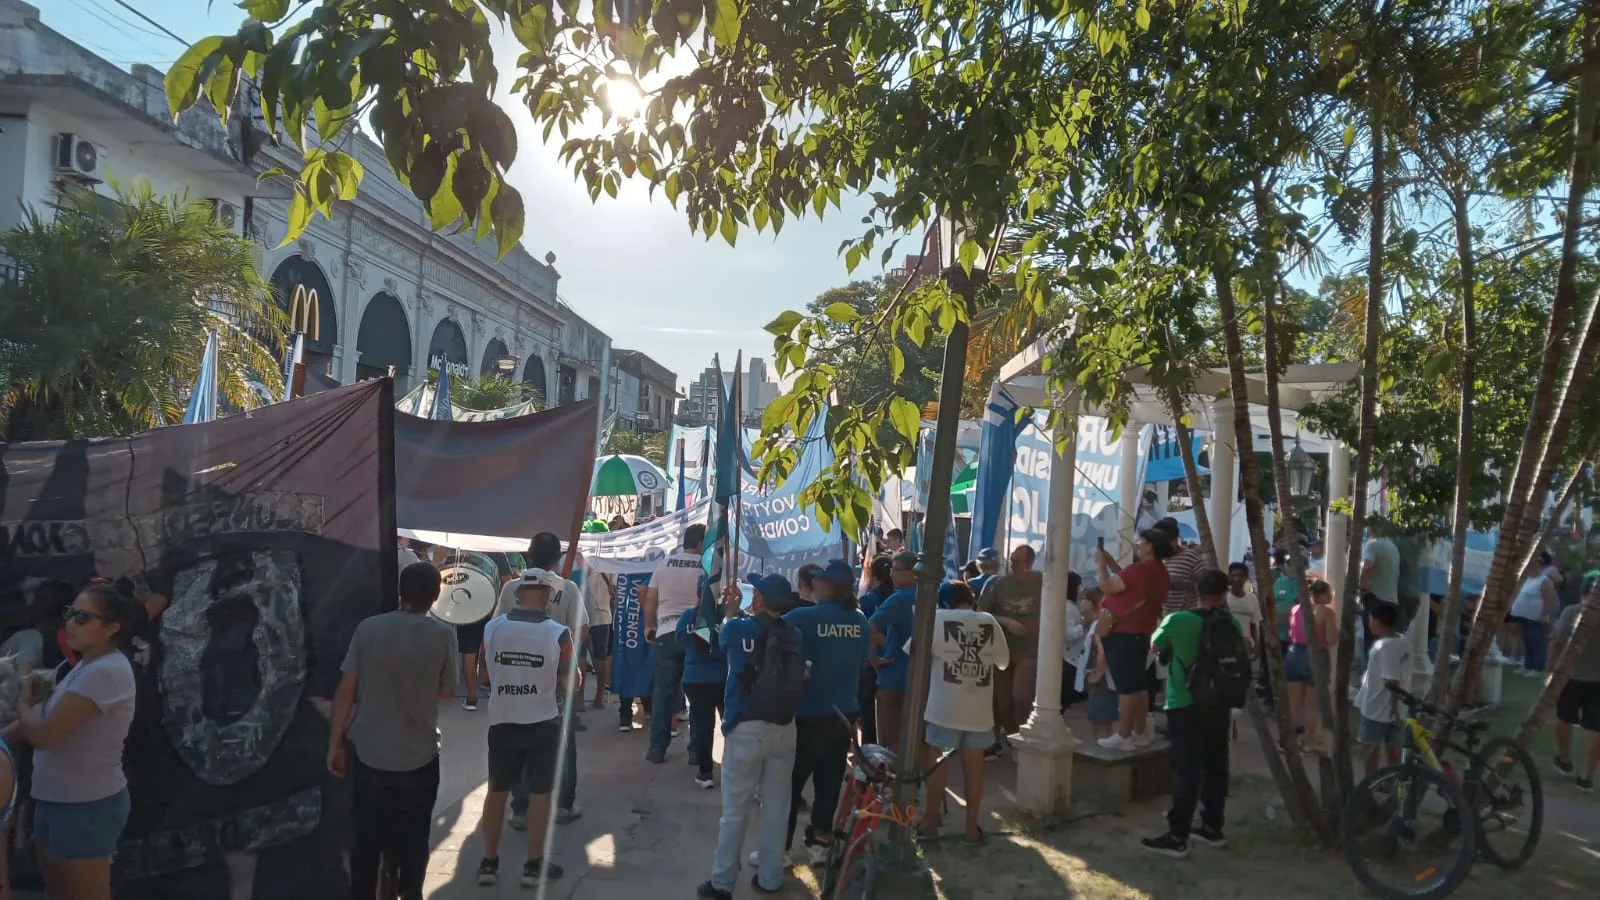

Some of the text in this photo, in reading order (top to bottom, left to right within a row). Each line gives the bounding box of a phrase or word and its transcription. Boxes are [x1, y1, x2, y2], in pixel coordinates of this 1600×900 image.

[817, 623, 861, 639] UATRE
[964, 646, 977, 662] IS
[497, 683, 538, 696] PRENSA
